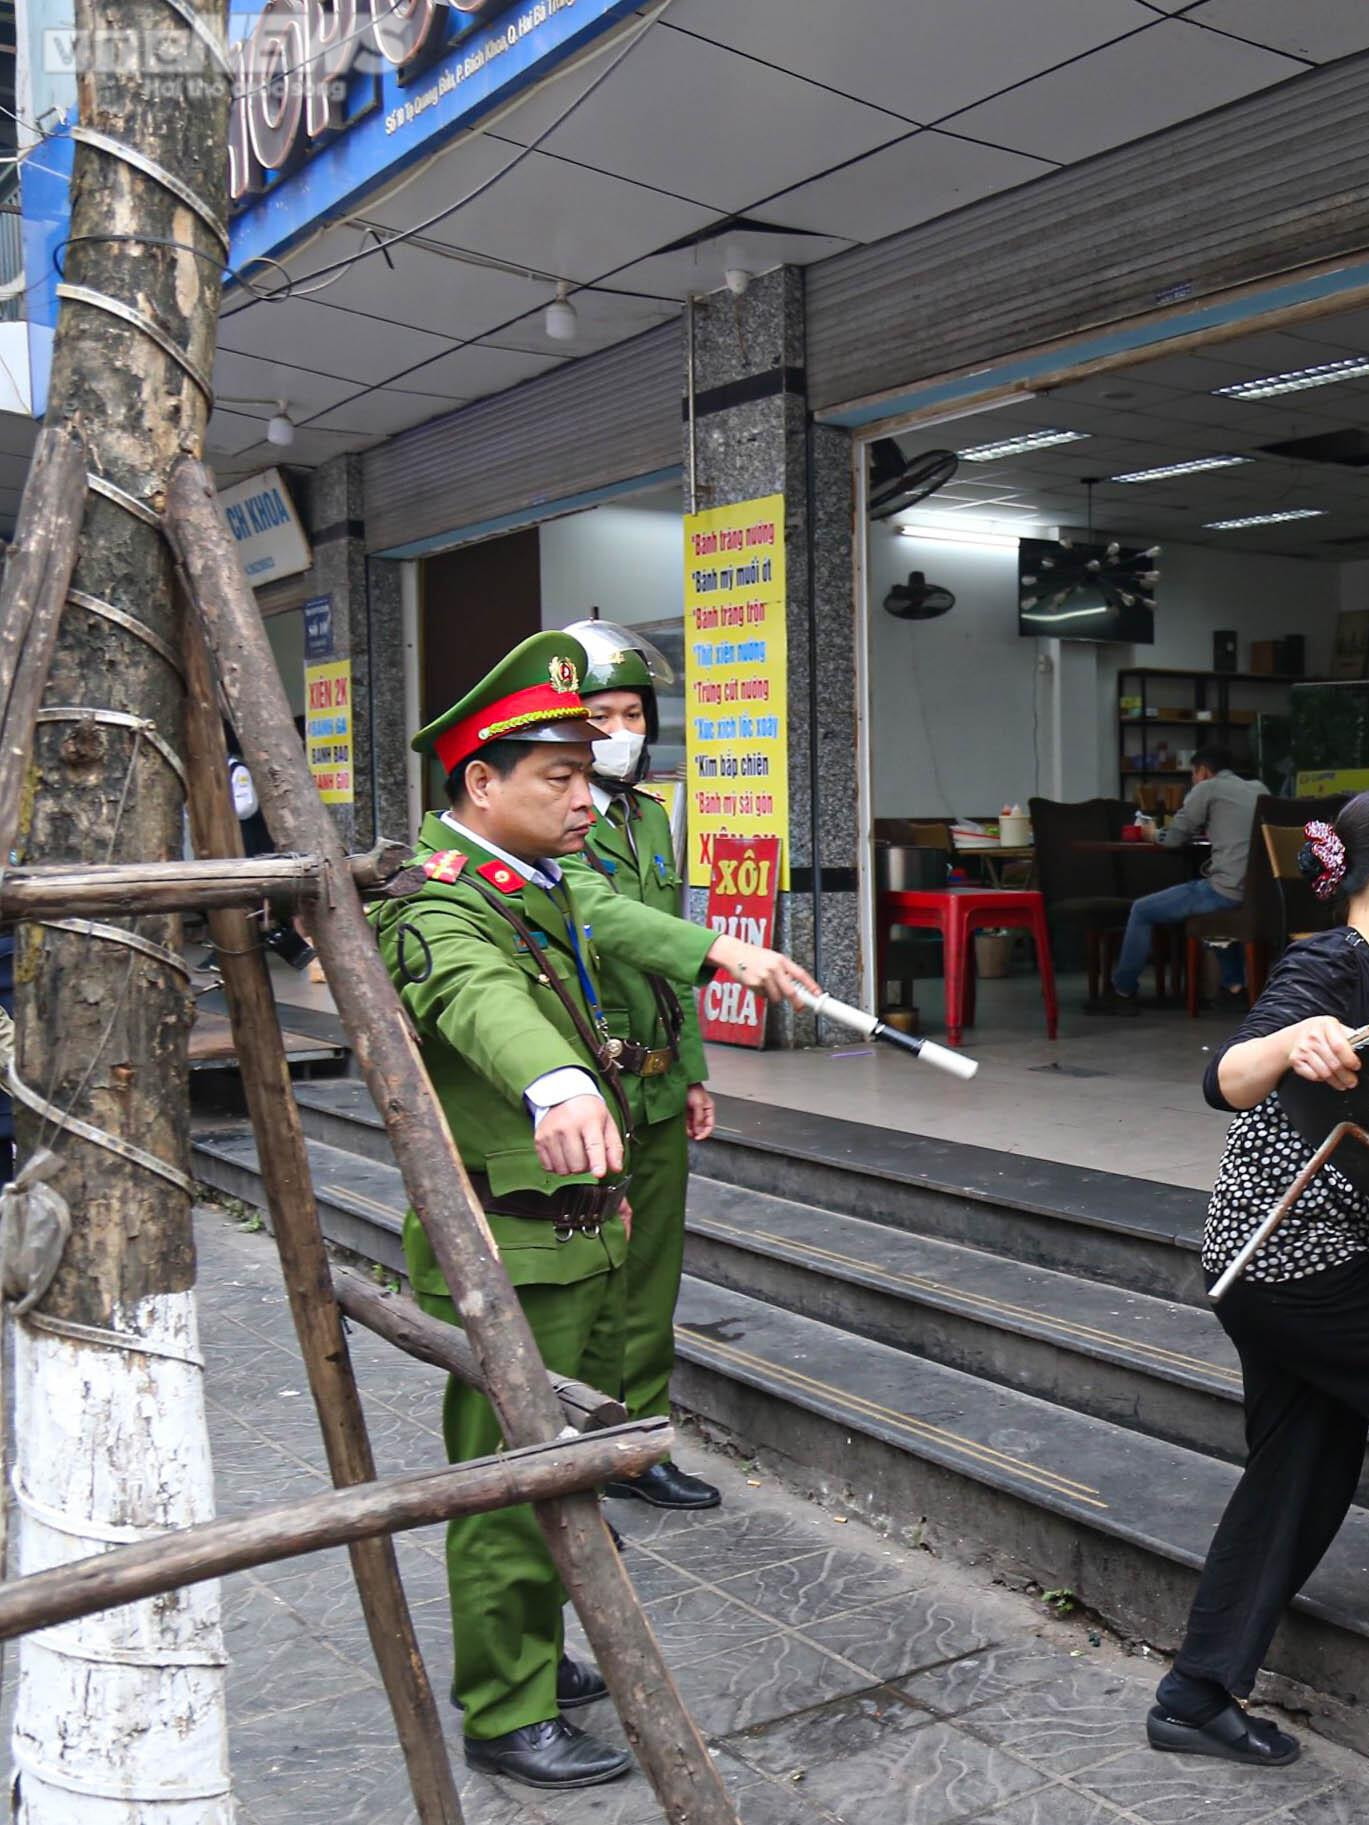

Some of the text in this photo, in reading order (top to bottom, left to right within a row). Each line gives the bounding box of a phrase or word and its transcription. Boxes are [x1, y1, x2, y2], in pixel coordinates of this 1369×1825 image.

[414, 90, 439, 115] Quang
[507, 25, 519, 44] Q.
[715, 849, 771, 897] XÔI
